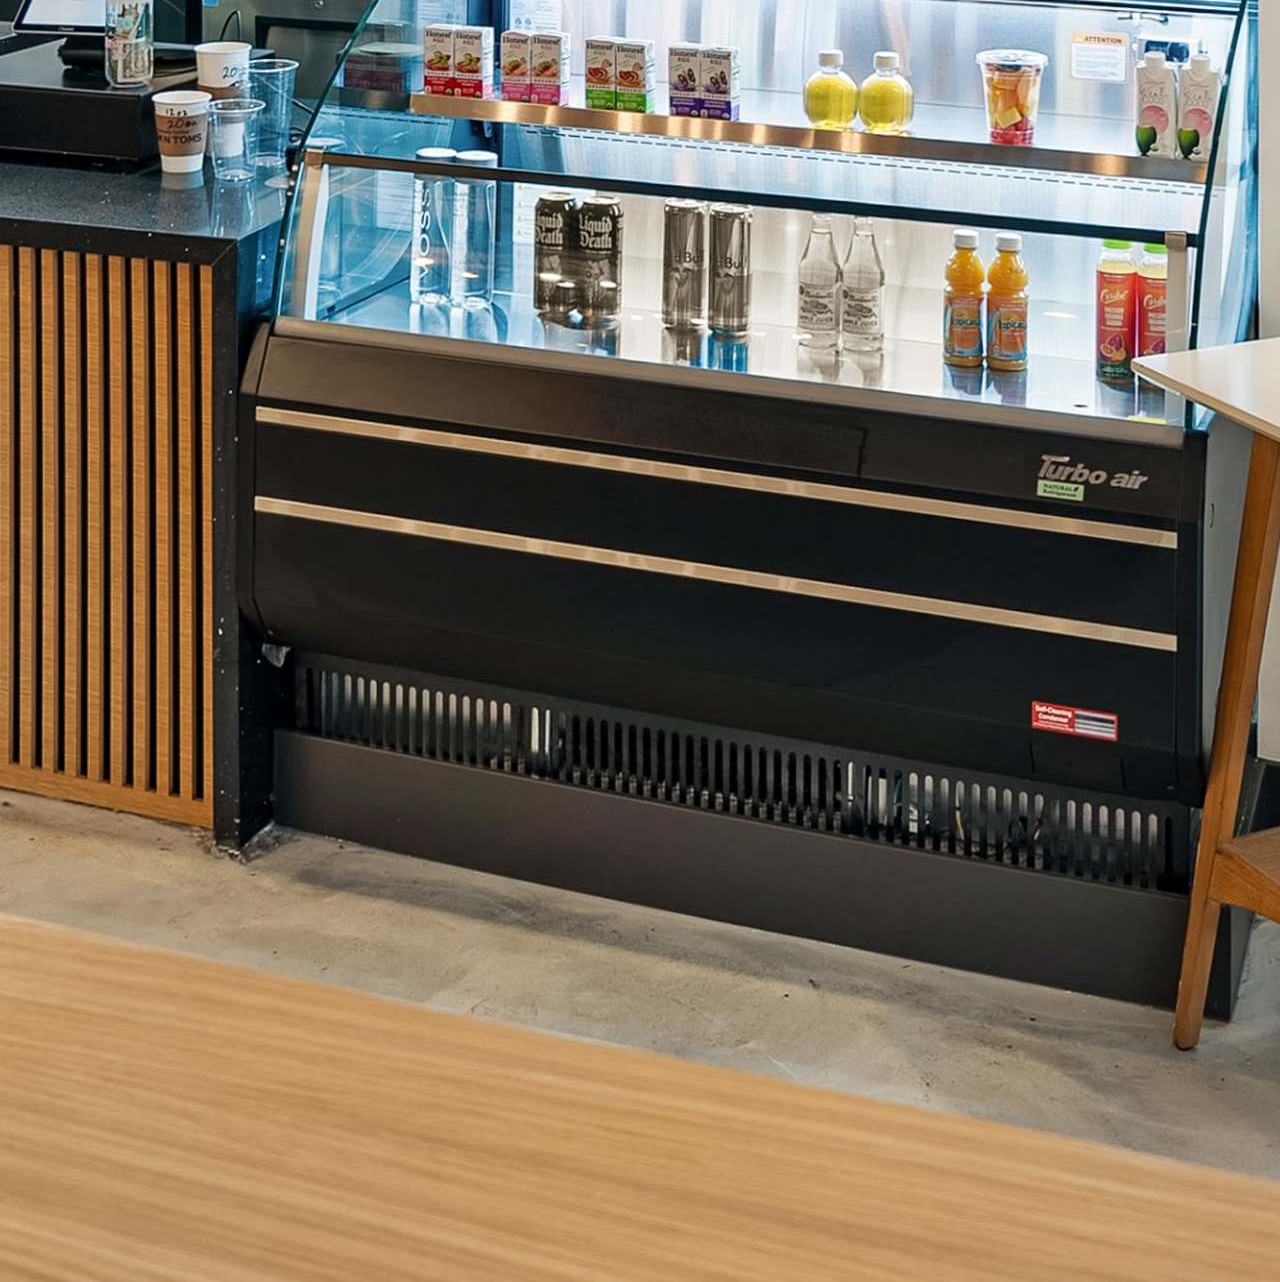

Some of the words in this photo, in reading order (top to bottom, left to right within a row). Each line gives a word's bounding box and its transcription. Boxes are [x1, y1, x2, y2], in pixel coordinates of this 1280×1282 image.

[1084, 35, 1122, 45] ATTENTION
[172, 133, 203, 145] TOMS
[535, 211, 564, 232] iquid
[578, 213, 614, 233] Liquid
[418, 188, 432, 280] VOSS
[579, 231, 613, 249] Death
[1038, 454, 1108, 485] Turbo
[1110, 470, 1149, 490] air
